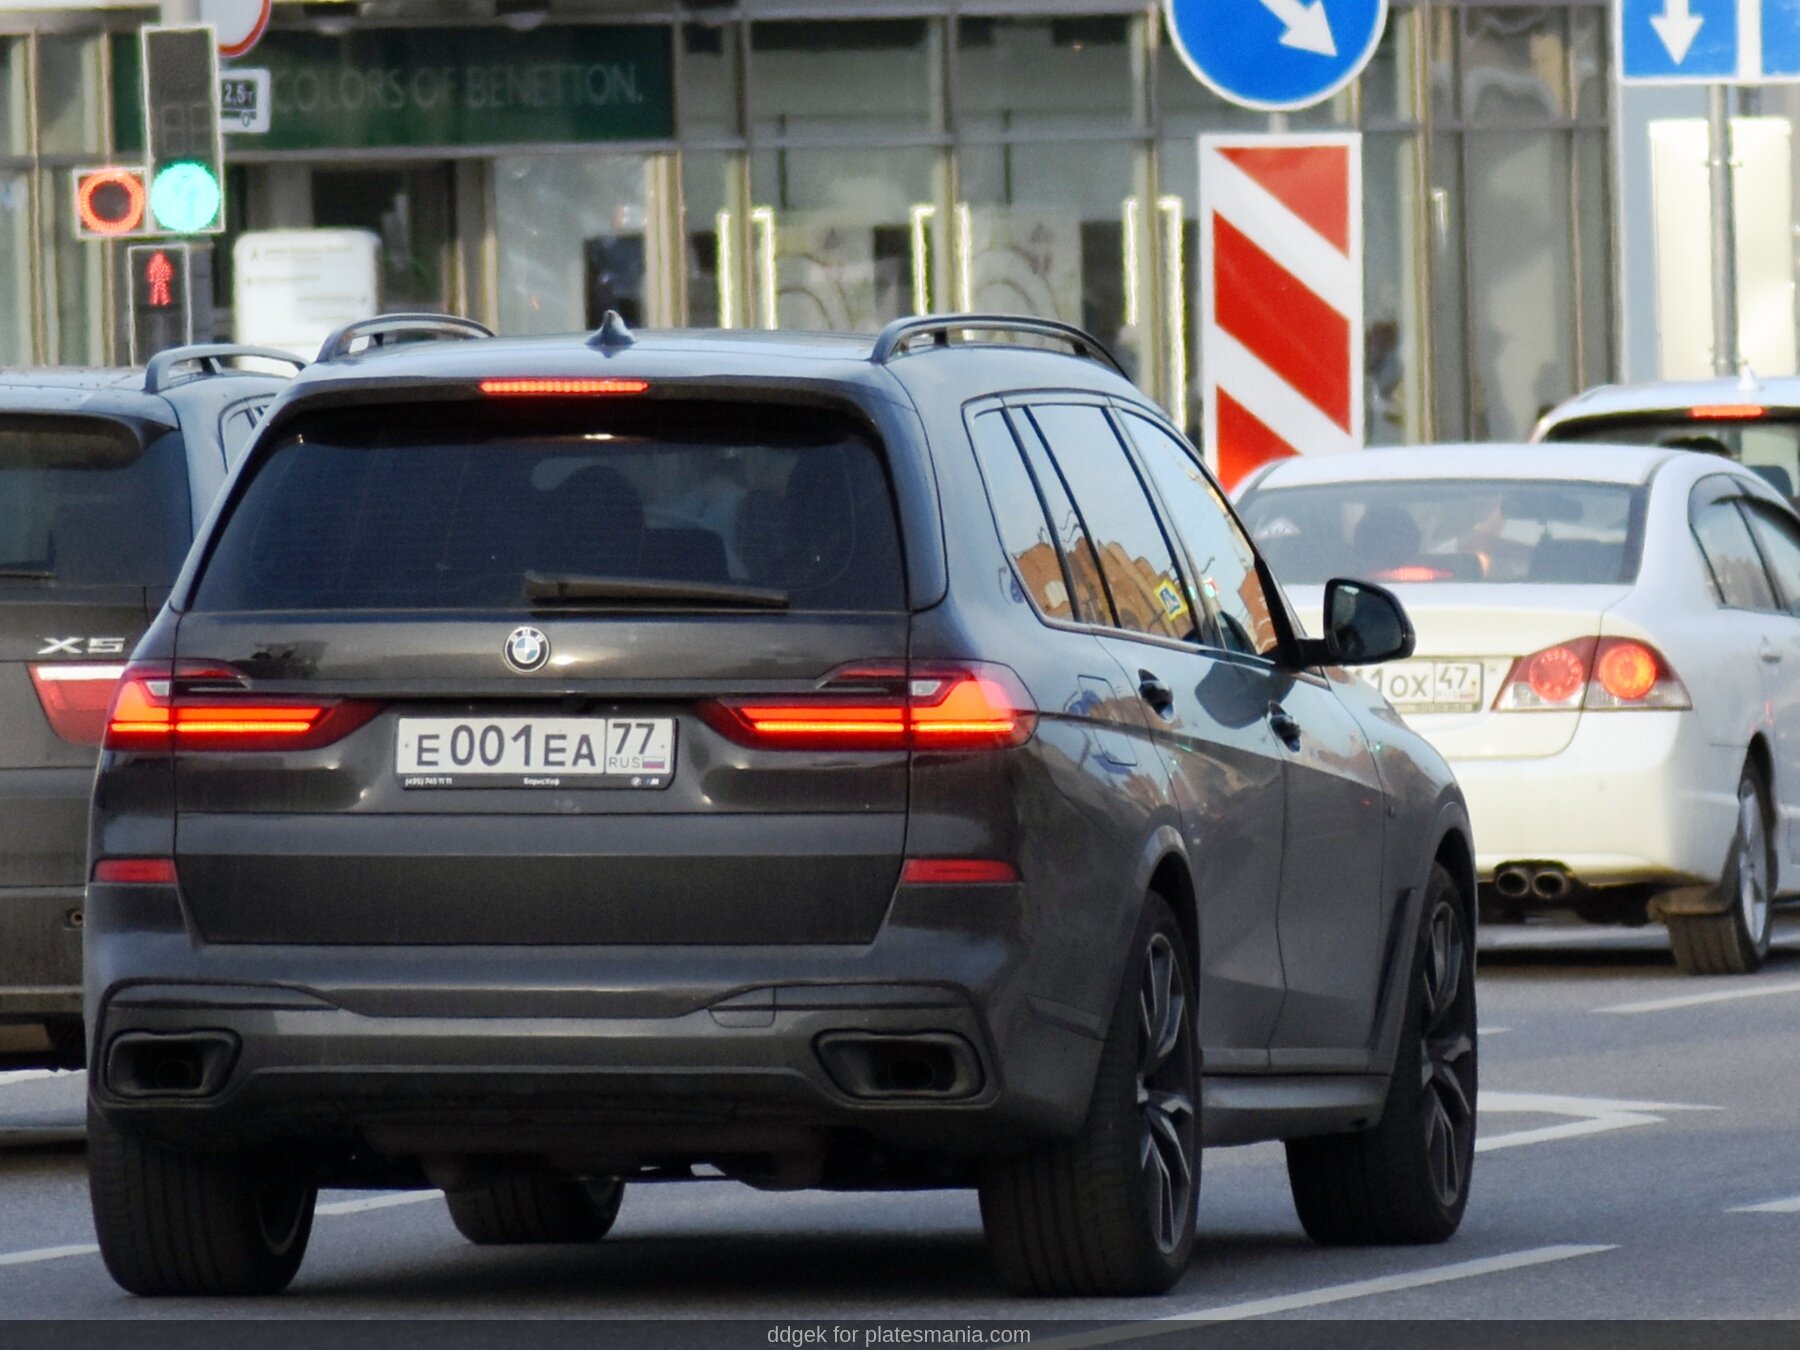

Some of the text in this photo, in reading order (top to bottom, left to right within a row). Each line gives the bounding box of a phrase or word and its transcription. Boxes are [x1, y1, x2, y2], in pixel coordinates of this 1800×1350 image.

[37, 637, 125, 655] X5
[1438, 666, 1469, 689] 47
[417, 724, 597, 767] E001EA
[612, 723, 656, 755] 77
[608, 756, 641, 769] RUS
